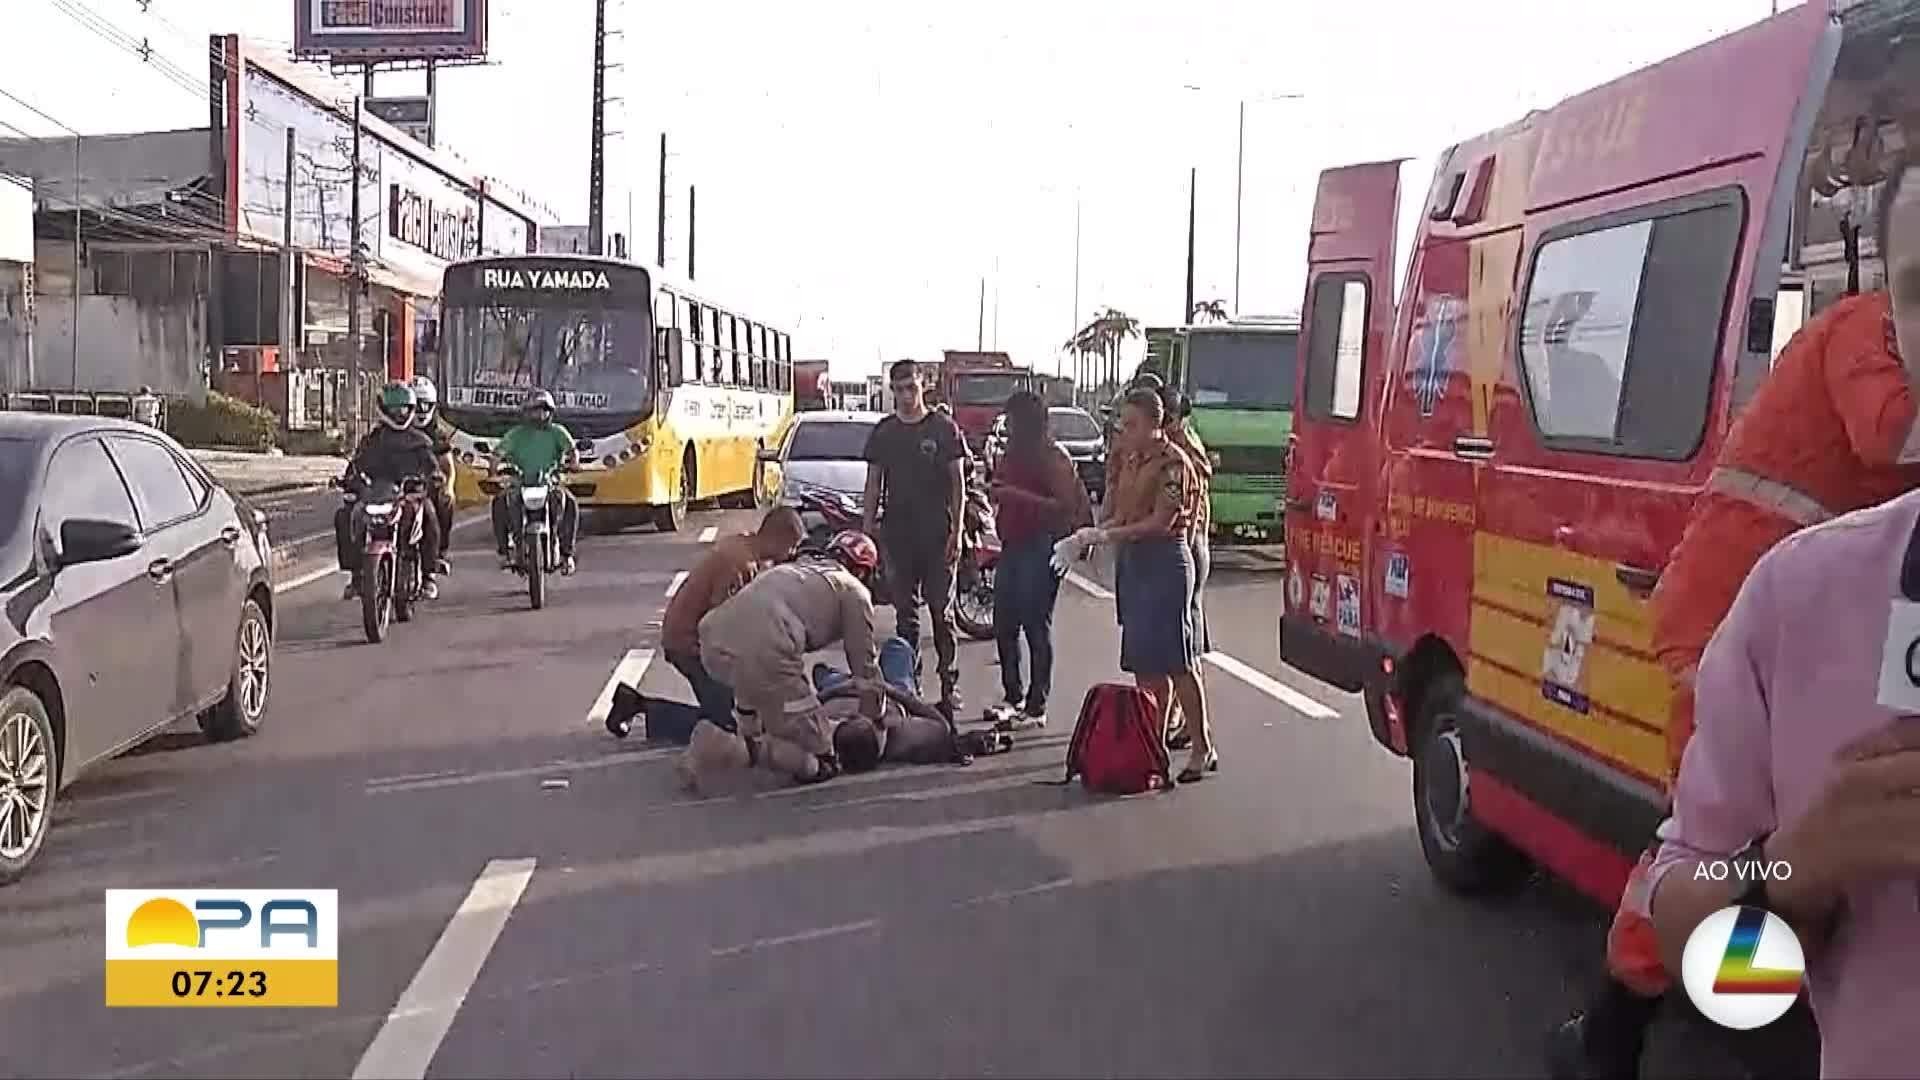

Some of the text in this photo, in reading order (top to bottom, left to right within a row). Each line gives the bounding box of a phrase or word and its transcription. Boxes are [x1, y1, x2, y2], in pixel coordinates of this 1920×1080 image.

[484, 269, 610, 289] RUA YAMADA
[474, 389, 530, 406] BENGU
